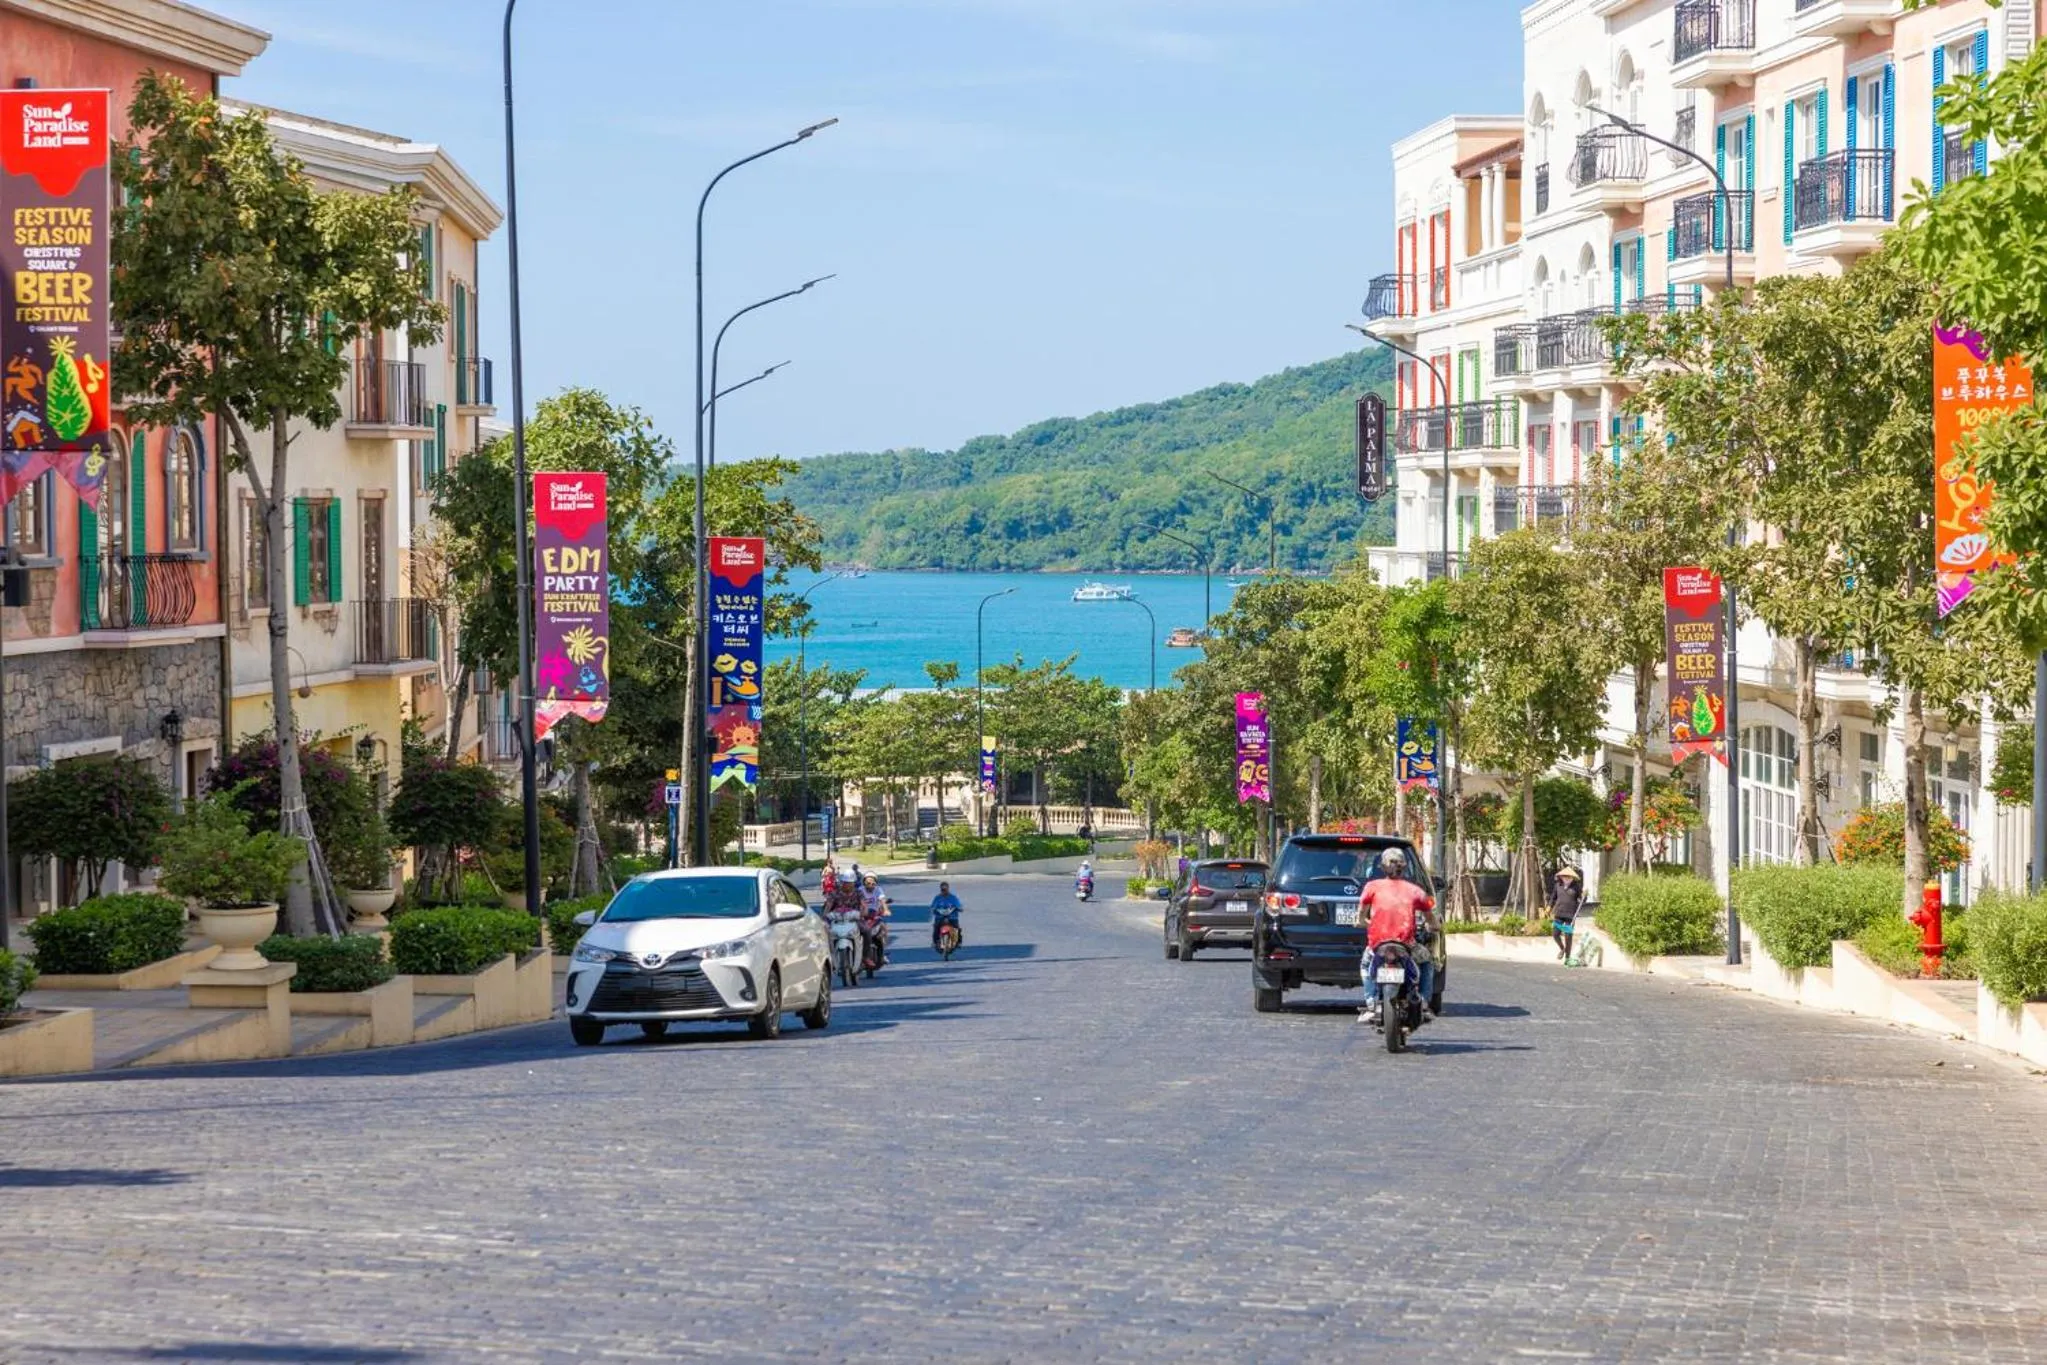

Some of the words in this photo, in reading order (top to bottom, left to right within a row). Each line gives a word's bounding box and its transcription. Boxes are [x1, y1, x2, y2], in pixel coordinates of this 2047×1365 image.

[23, 104, 53, 119] Sun
[24, 117, 89, 133] Paradise
[24, 133, 62, 148] Land
[14, 208, 93, 227] FESTIVE
[15, 228, 92, 246] SEASON
[15, 271, 93, 305] BEER
[16, 307, 92, 323] FESTIVAL
[1941, 384, 2029, 401] 브루하우스
[550, 482, 570, 492] Sun
[551, 490, 594, 501] Paradise
[551, 501, 576, 511] Land
[542, 546, 602, 574] EDM
[543, 575, 600, 592] PARTY
[544, 601, 602, 613] FESTIVAL
[1674, 623, 1715, 633] FESTIVE
[1674, 632, 1715, 643] SEASON
[1675, 654, 1716, 671] BEER
[1676, 671, 1715, 680] FESTIVAL
